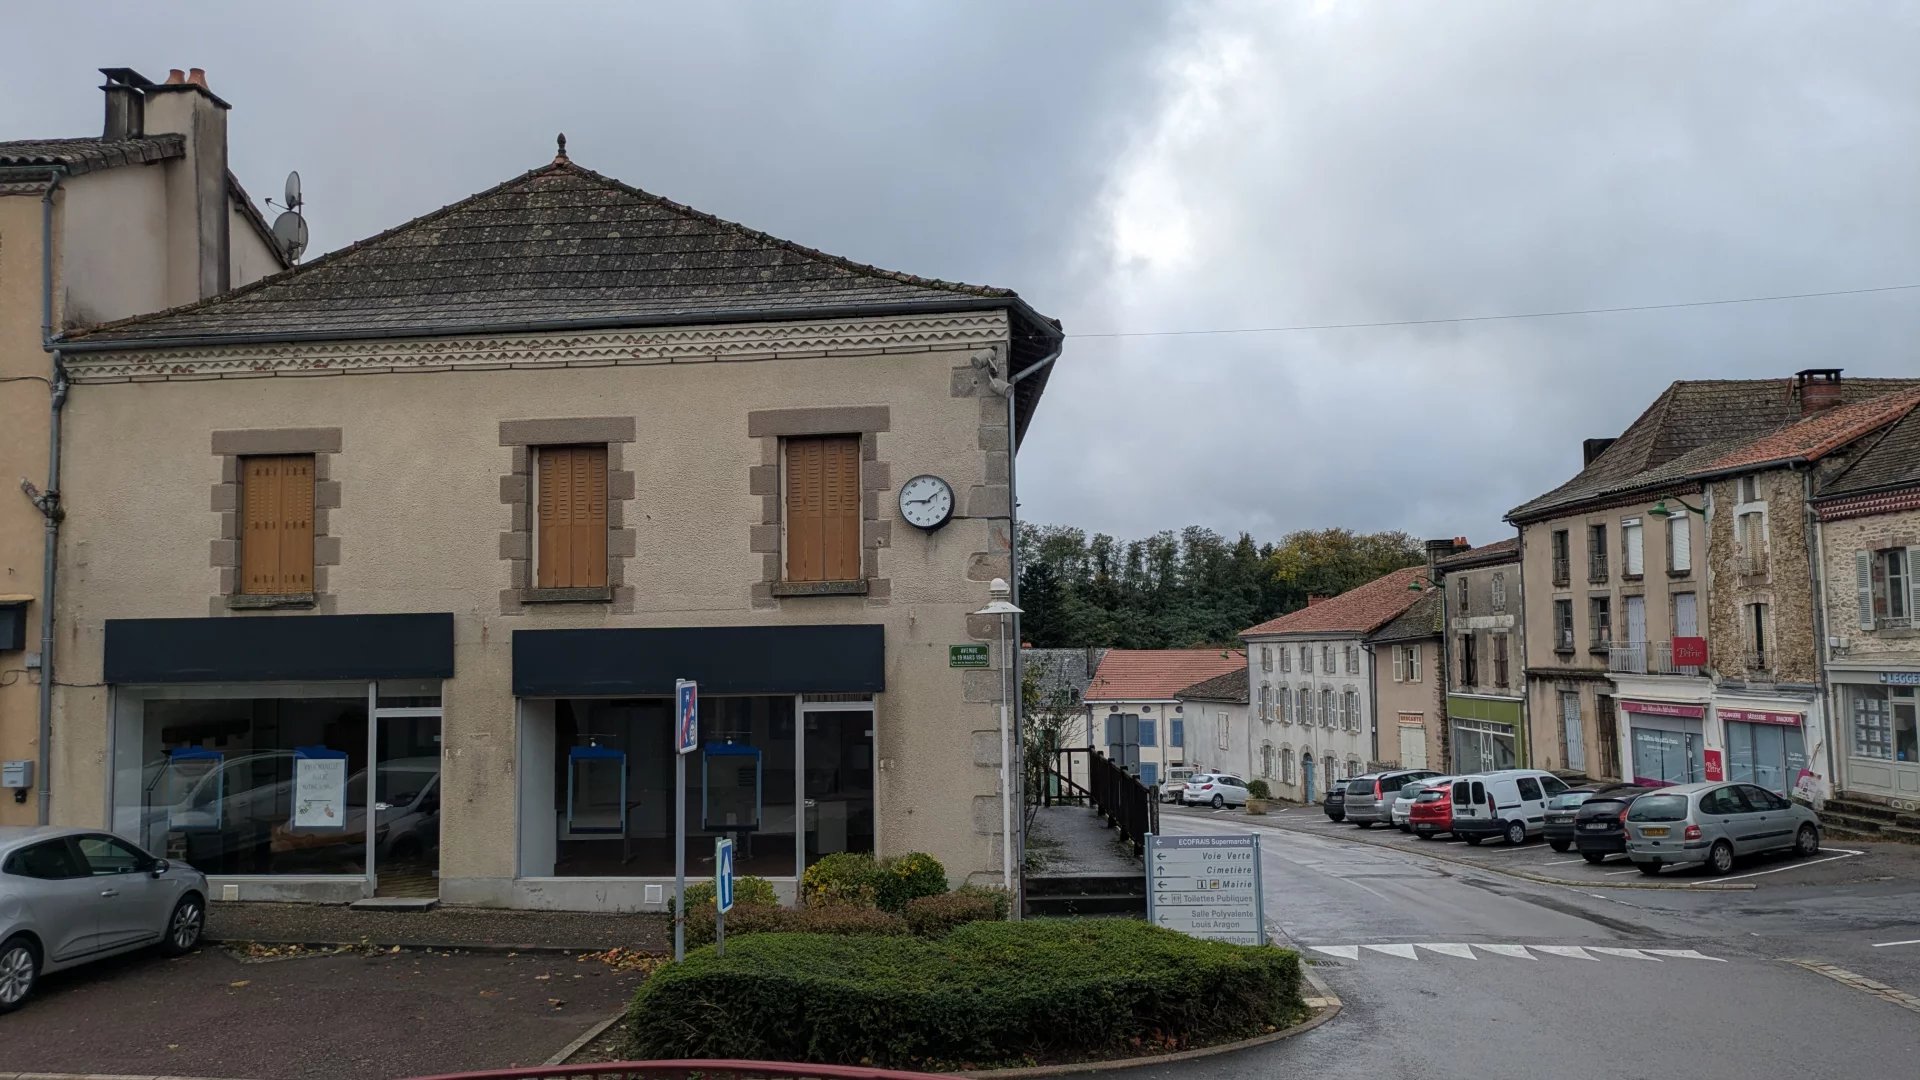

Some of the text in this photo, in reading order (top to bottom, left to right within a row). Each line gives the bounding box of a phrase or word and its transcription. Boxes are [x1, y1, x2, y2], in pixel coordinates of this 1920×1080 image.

[1178, 838, 1251, 846] ECOFRAIS Supermarché
[1202, 851, 1251, 860] Voie Verte
[1206, 866, 1252, 874] Cimetière
[1222, 880, 1253, 889] Mairie
[1183, 894, 1253, 903] Toilettes Publiques
[1191, 909, 1254, 919] Salle Polyvalente
[1191, 920, 1240, 929] Louis Aragon
